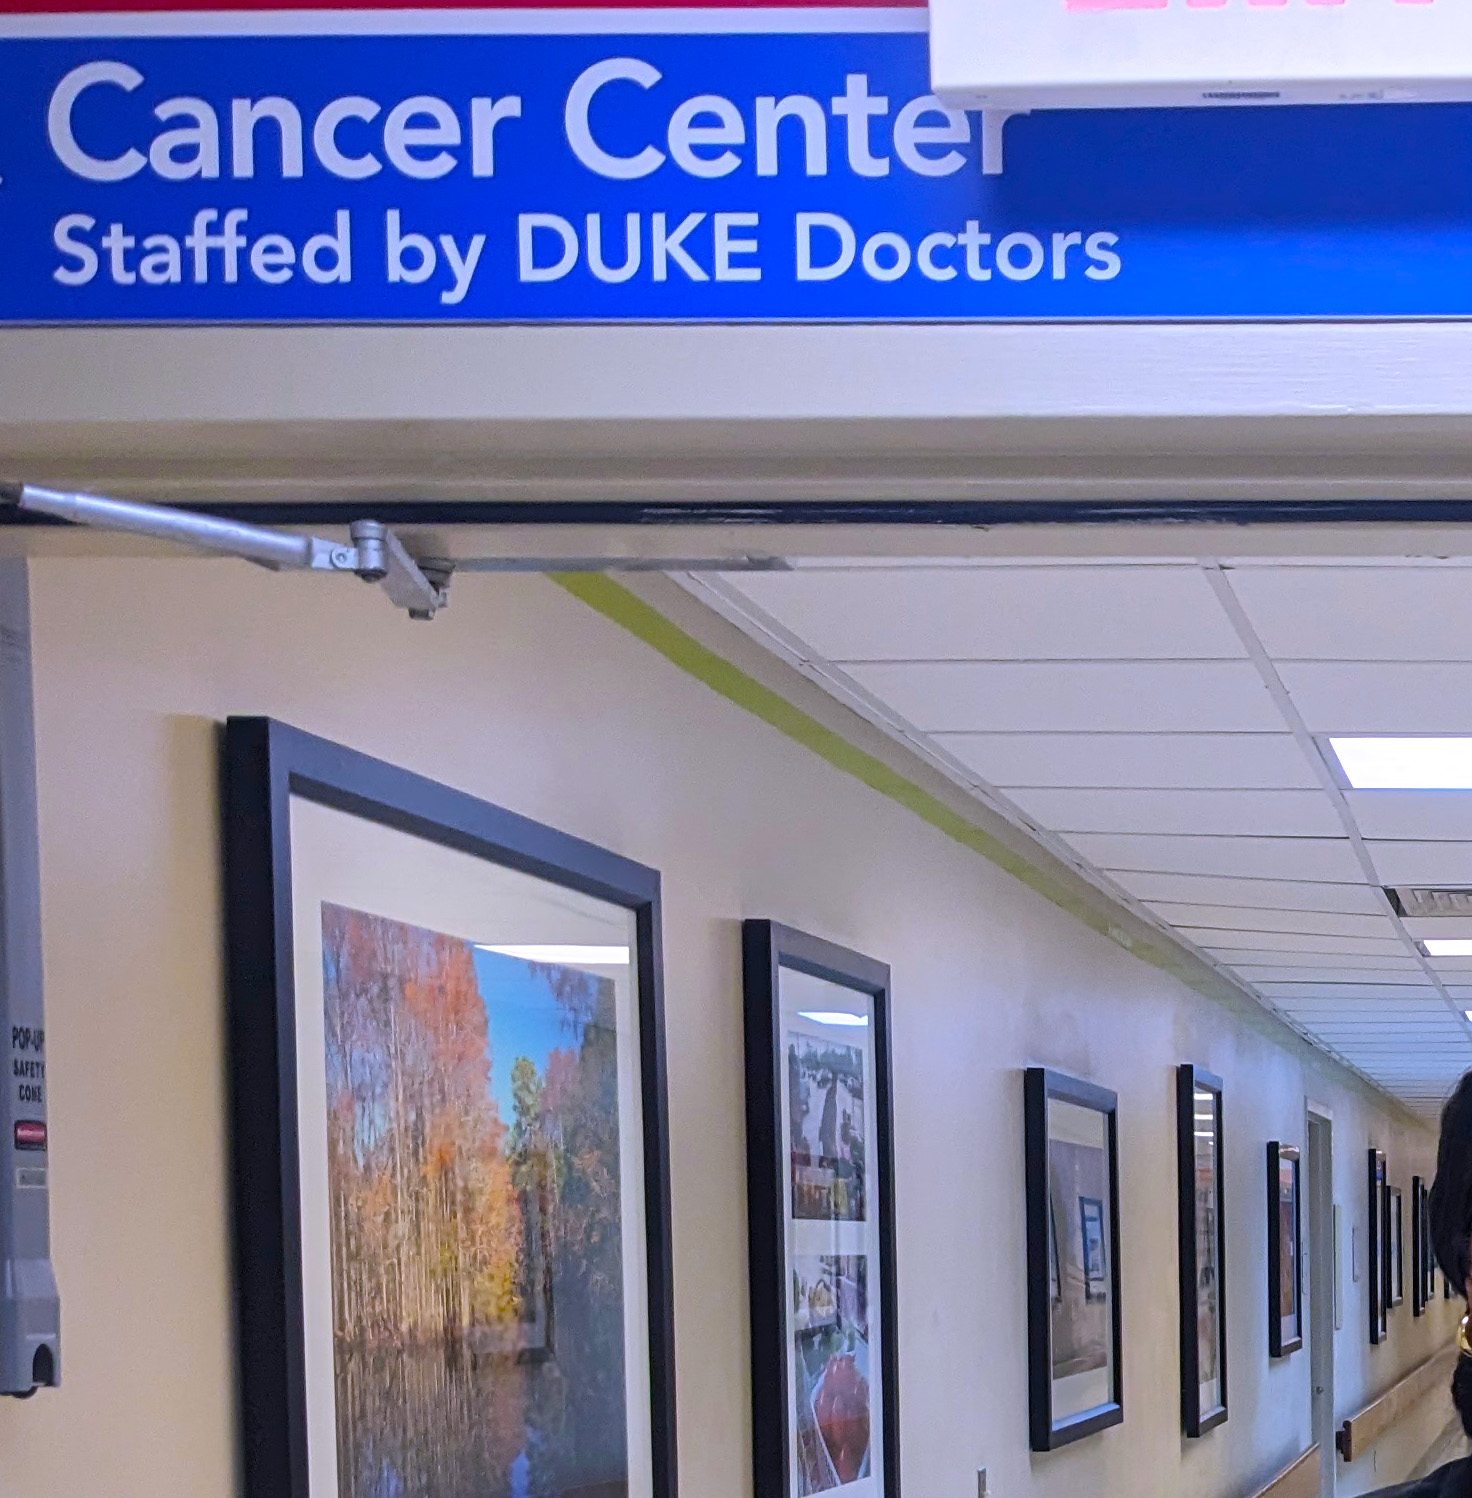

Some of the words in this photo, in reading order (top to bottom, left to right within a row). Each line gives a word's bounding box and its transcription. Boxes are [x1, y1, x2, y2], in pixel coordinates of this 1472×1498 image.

[48, 60, 522, 182] Cancer
[565, 57, 1031, 180] Center
[54, 209, 352, 285] Staffed
[387, 209, 486, 305] by
[519, 212, 762, 284] DUKE
[796, 211, 1122, 282] Doctors
[12, 1025, 45, 1052] POP-UP
[13, 1058, 45, 1079] SAFETY
[18, 1083, 43, 1103] CONE
